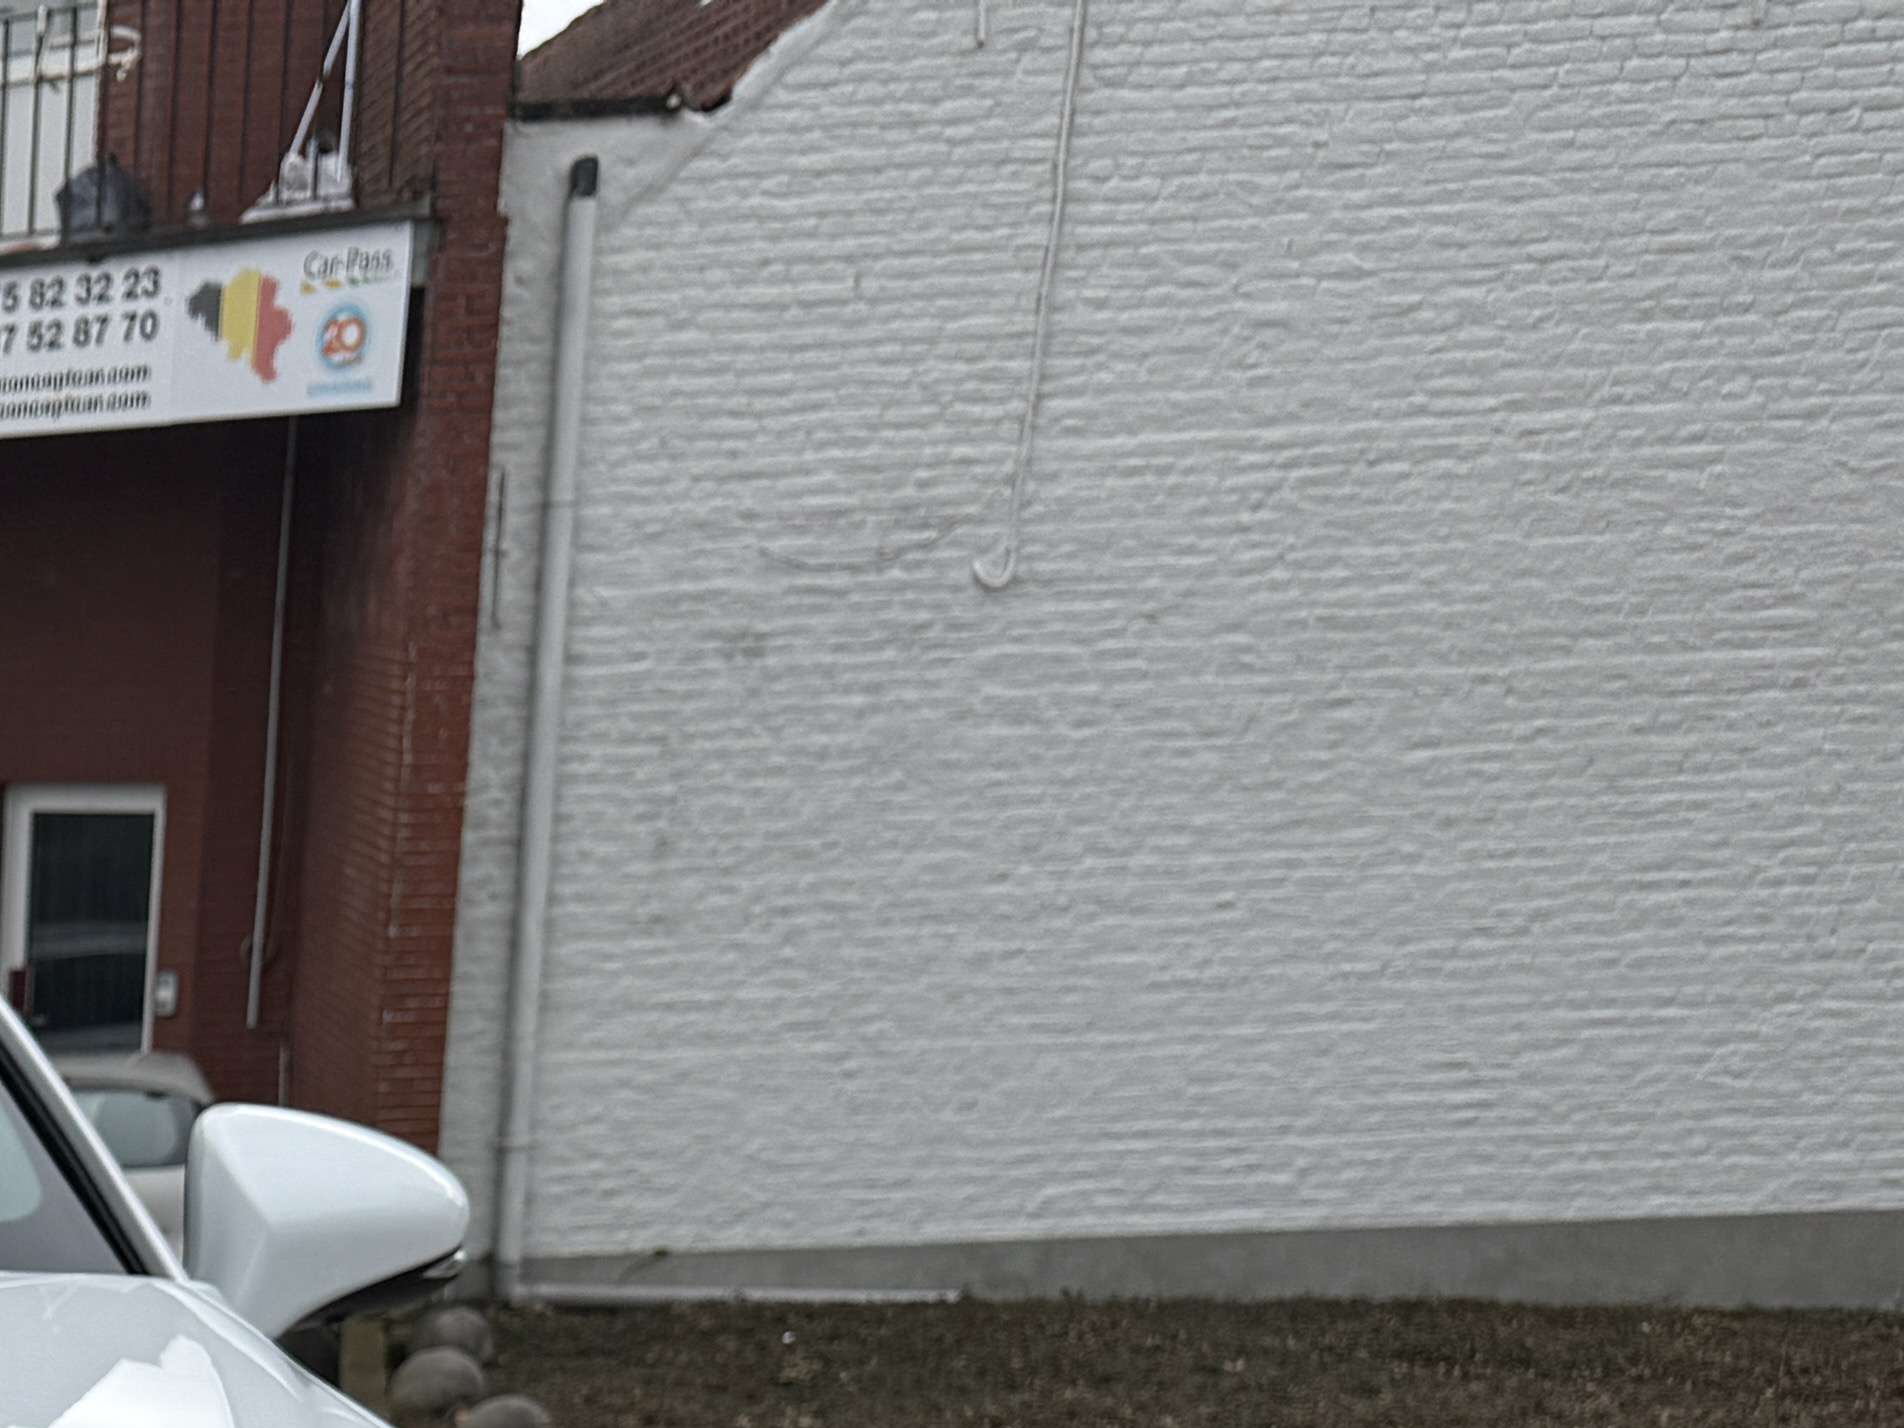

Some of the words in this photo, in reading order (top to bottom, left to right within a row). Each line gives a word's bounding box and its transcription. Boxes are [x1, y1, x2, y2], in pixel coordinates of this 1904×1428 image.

[28, 273, 67, 311] 82
[74, 268, 114, 306] 32
[121, 265, 161, 302] 23
[26, 317, 66, 353] 52
[72, 311, 112, 348] 87
[121, 307, 160, 344] 70
